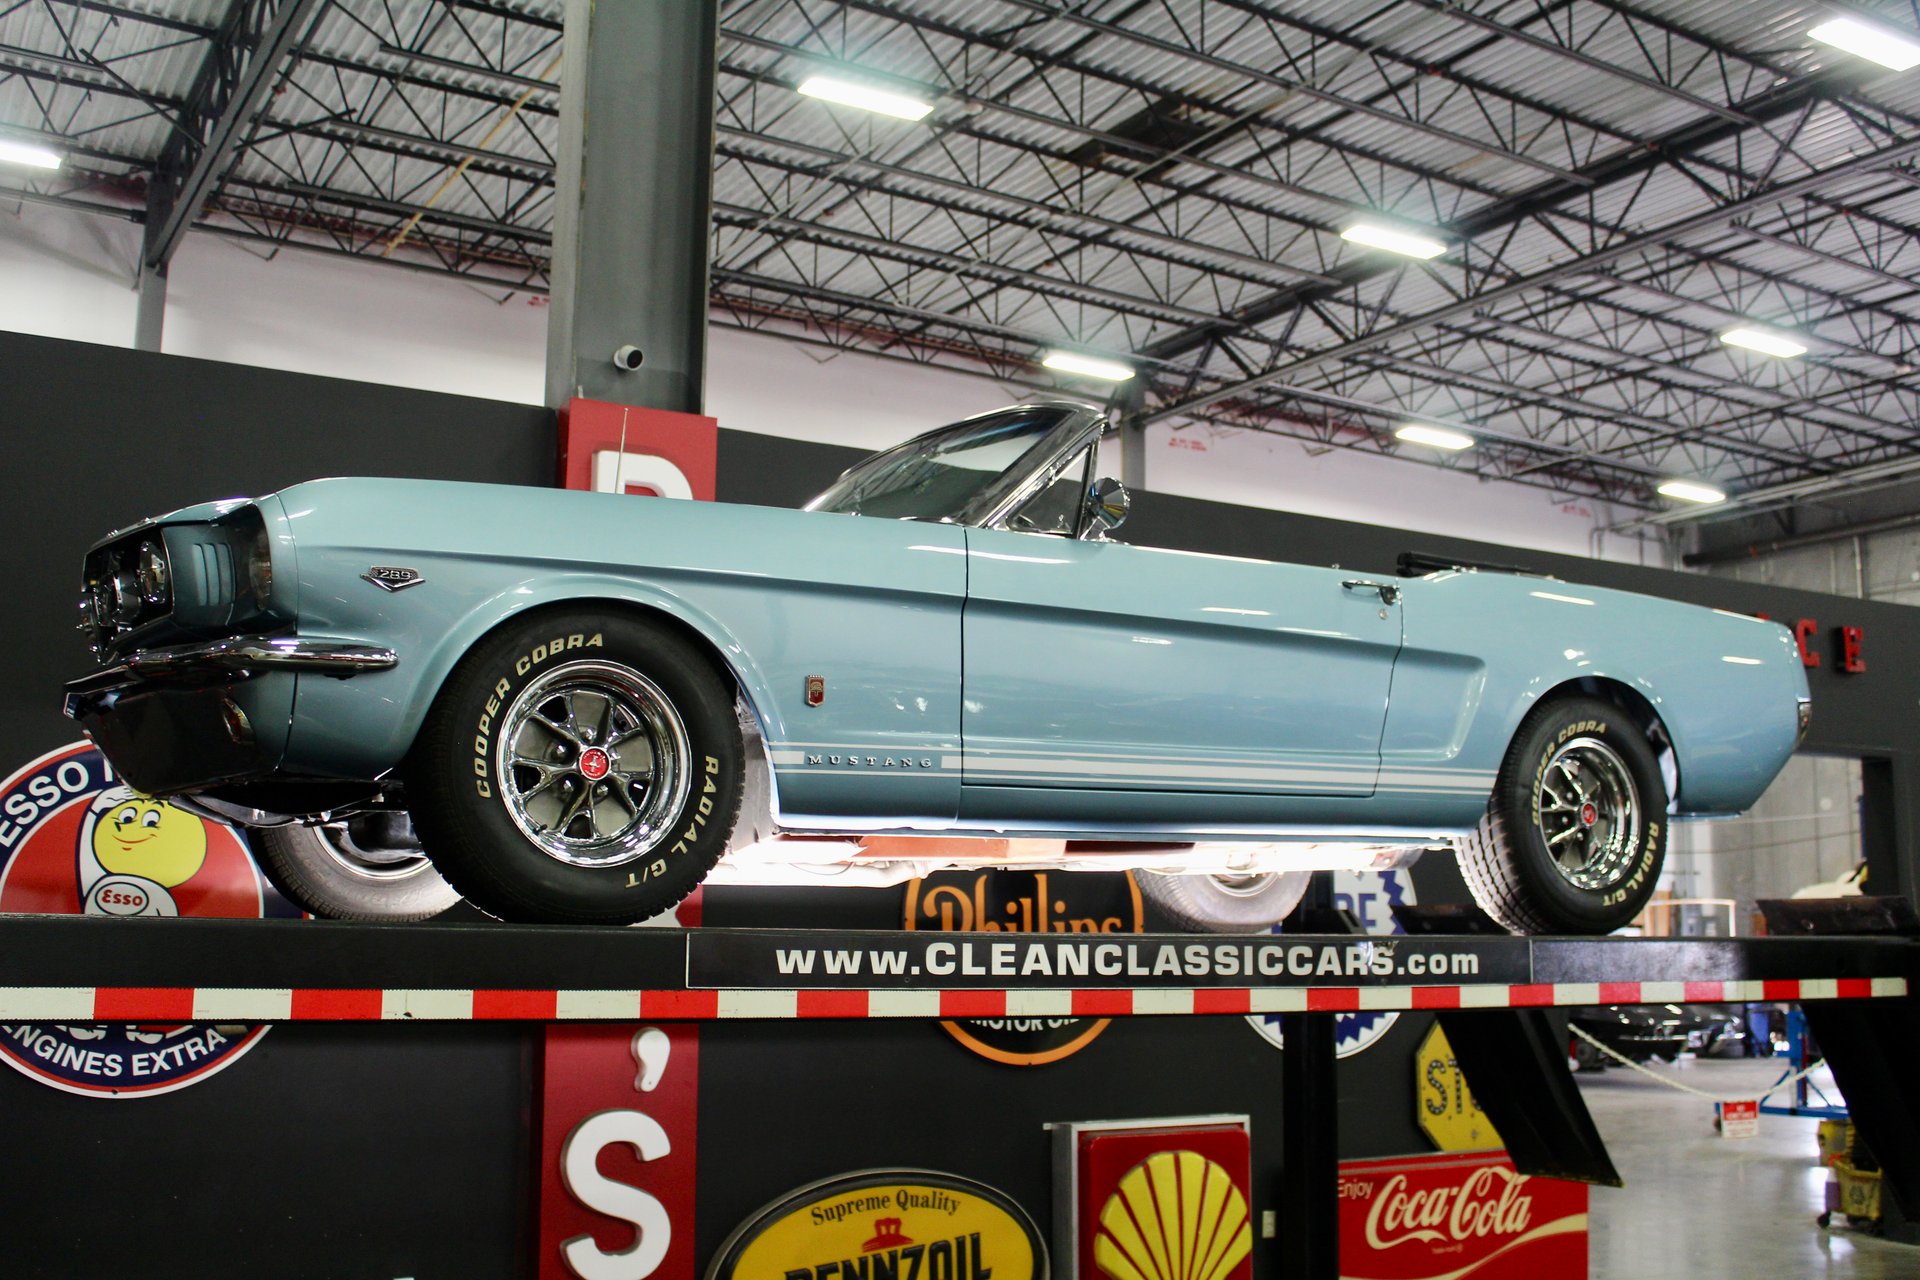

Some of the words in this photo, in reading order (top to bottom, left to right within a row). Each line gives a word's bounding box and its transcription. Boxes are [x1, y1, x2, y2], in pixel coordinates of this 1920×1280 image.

[380, 569, 411, 580] 289
[474, 678, 511, 798] COOPER
[515, 633, 603, 677] COBRA
[1558, 720, 1606, 743] COBRA
[808, 754, 932, 768] MUSTANG
[0, 761, 89, 848] ESSO
[670, 755, 719, 855] RADIAL
[625, 858, 668, 889] G/T
[1626, 821, 1659, 891] RADIAL
[1602, 889, 1637, 906] G/T
[775, 942, 1479, 977] www.CLEANCLASSICCARS.com
[970, 1019, 1044, 1032] OTOR
[0, 1024, 123, 1077] NGINES
[131, 1027, 228, 1076] EXTRA
[1426, 1058, 1482, 1116] ST
[1338, 1179, 1374, 1200] Enjoy
[811, 1196, 891, 1226] Supreme
[896, 1190, 961, 1216] Quality
[1365, 1166, 1532, 1250] Coca-Cola
[784, 1232, 992, 1280] NNZOIL
